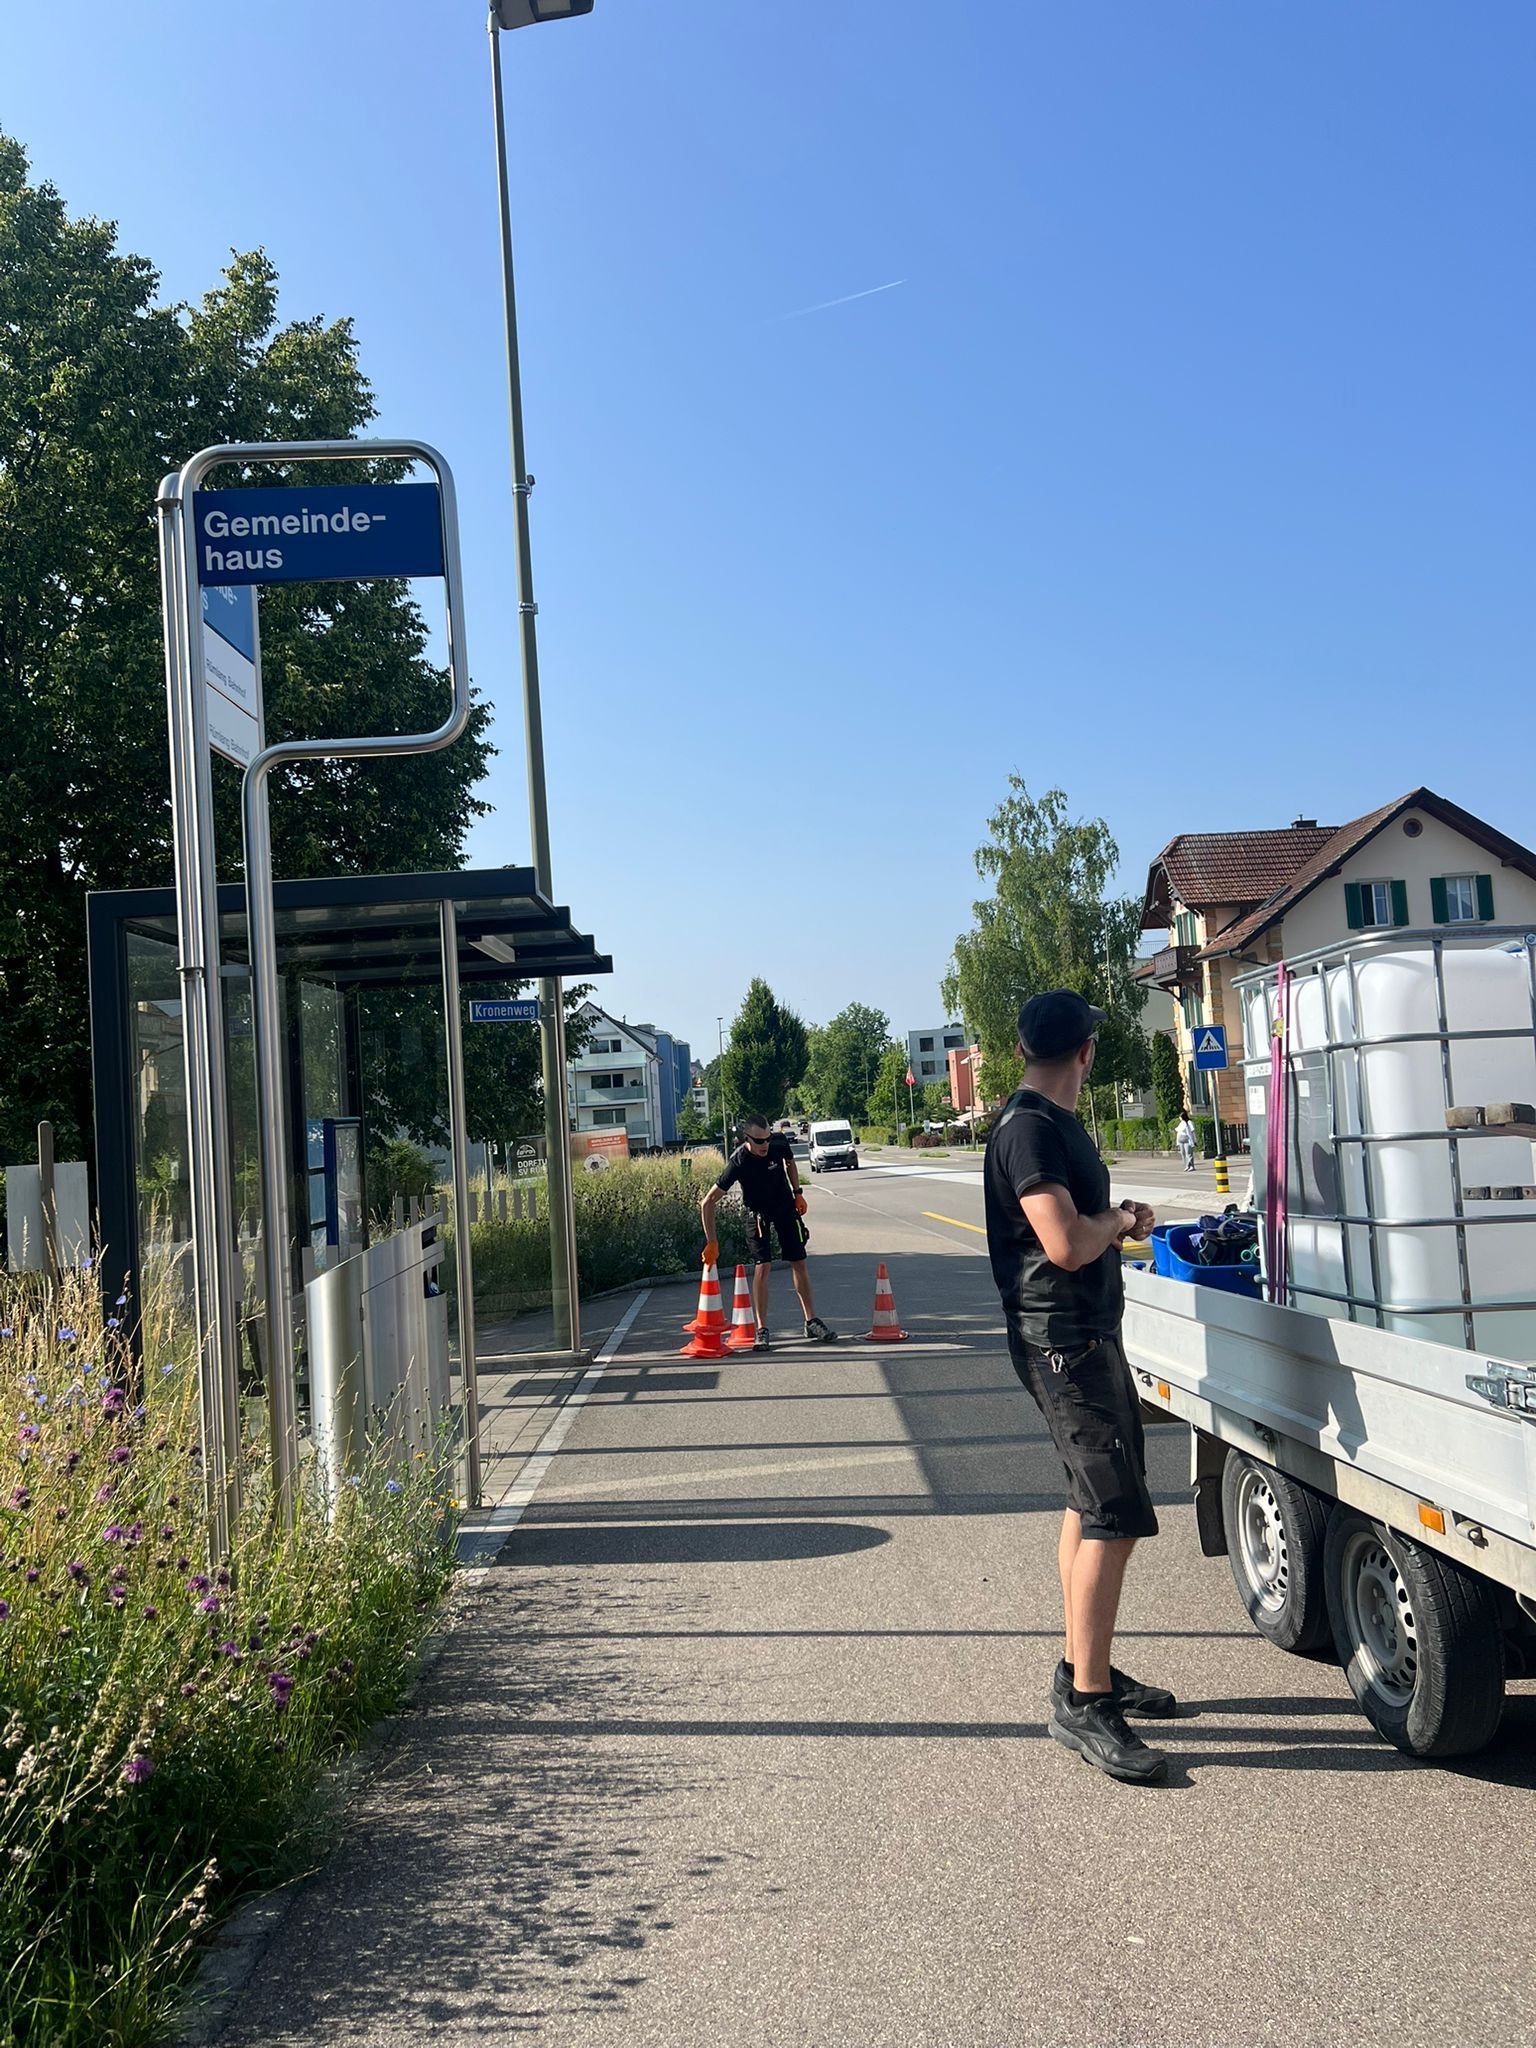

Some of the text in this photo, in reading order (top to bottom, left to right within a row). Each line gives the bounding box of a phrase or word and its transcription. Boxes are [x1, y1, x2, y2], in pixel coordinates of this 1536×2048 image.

[203, 506, 387, 538] Gemeinde-
[205, 545, 284, 572] haus
[475, 1004, 536, 1019] Kronenweg
[517, 1158, 548, 1169] DORFTU
